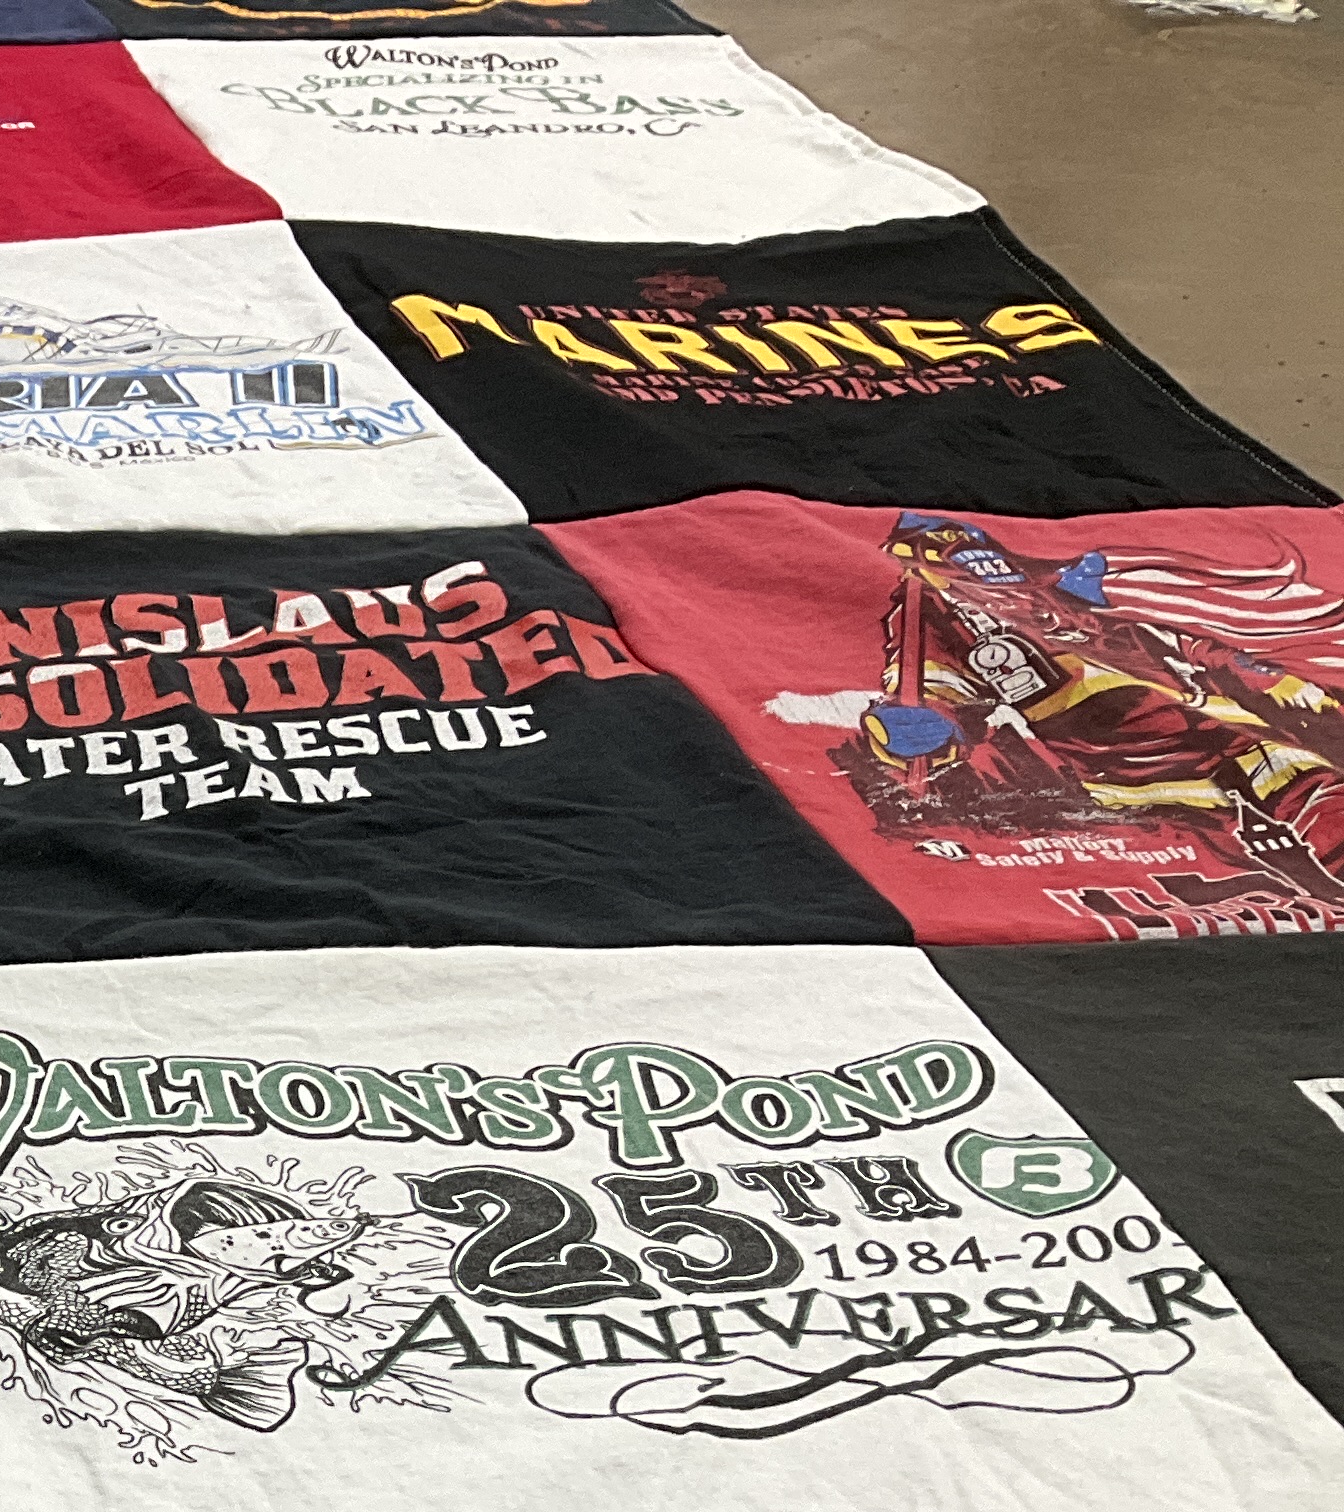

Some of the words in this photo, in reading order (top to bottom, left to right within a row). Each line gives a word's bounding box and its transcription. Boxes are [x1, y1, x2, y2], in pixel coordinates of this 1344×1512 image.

[388, 293, 1104, 375] MARINES
[518, 303, 698, 324] UNITED
[716, 304, 910, 323] STATES
[230, 360, 340, 409] II
[98, 439, 176, 461] DEL
[185, 439, 261, 456] SOL
[213, 704, 548, 764] RESCUE
[124, 761, 373, 823] TEAM
[975, 851, 1064, 868] Safety
[1018, 833, 1127, 854] Mallory
[821, 1214, 1188, 1284] 1984-200
